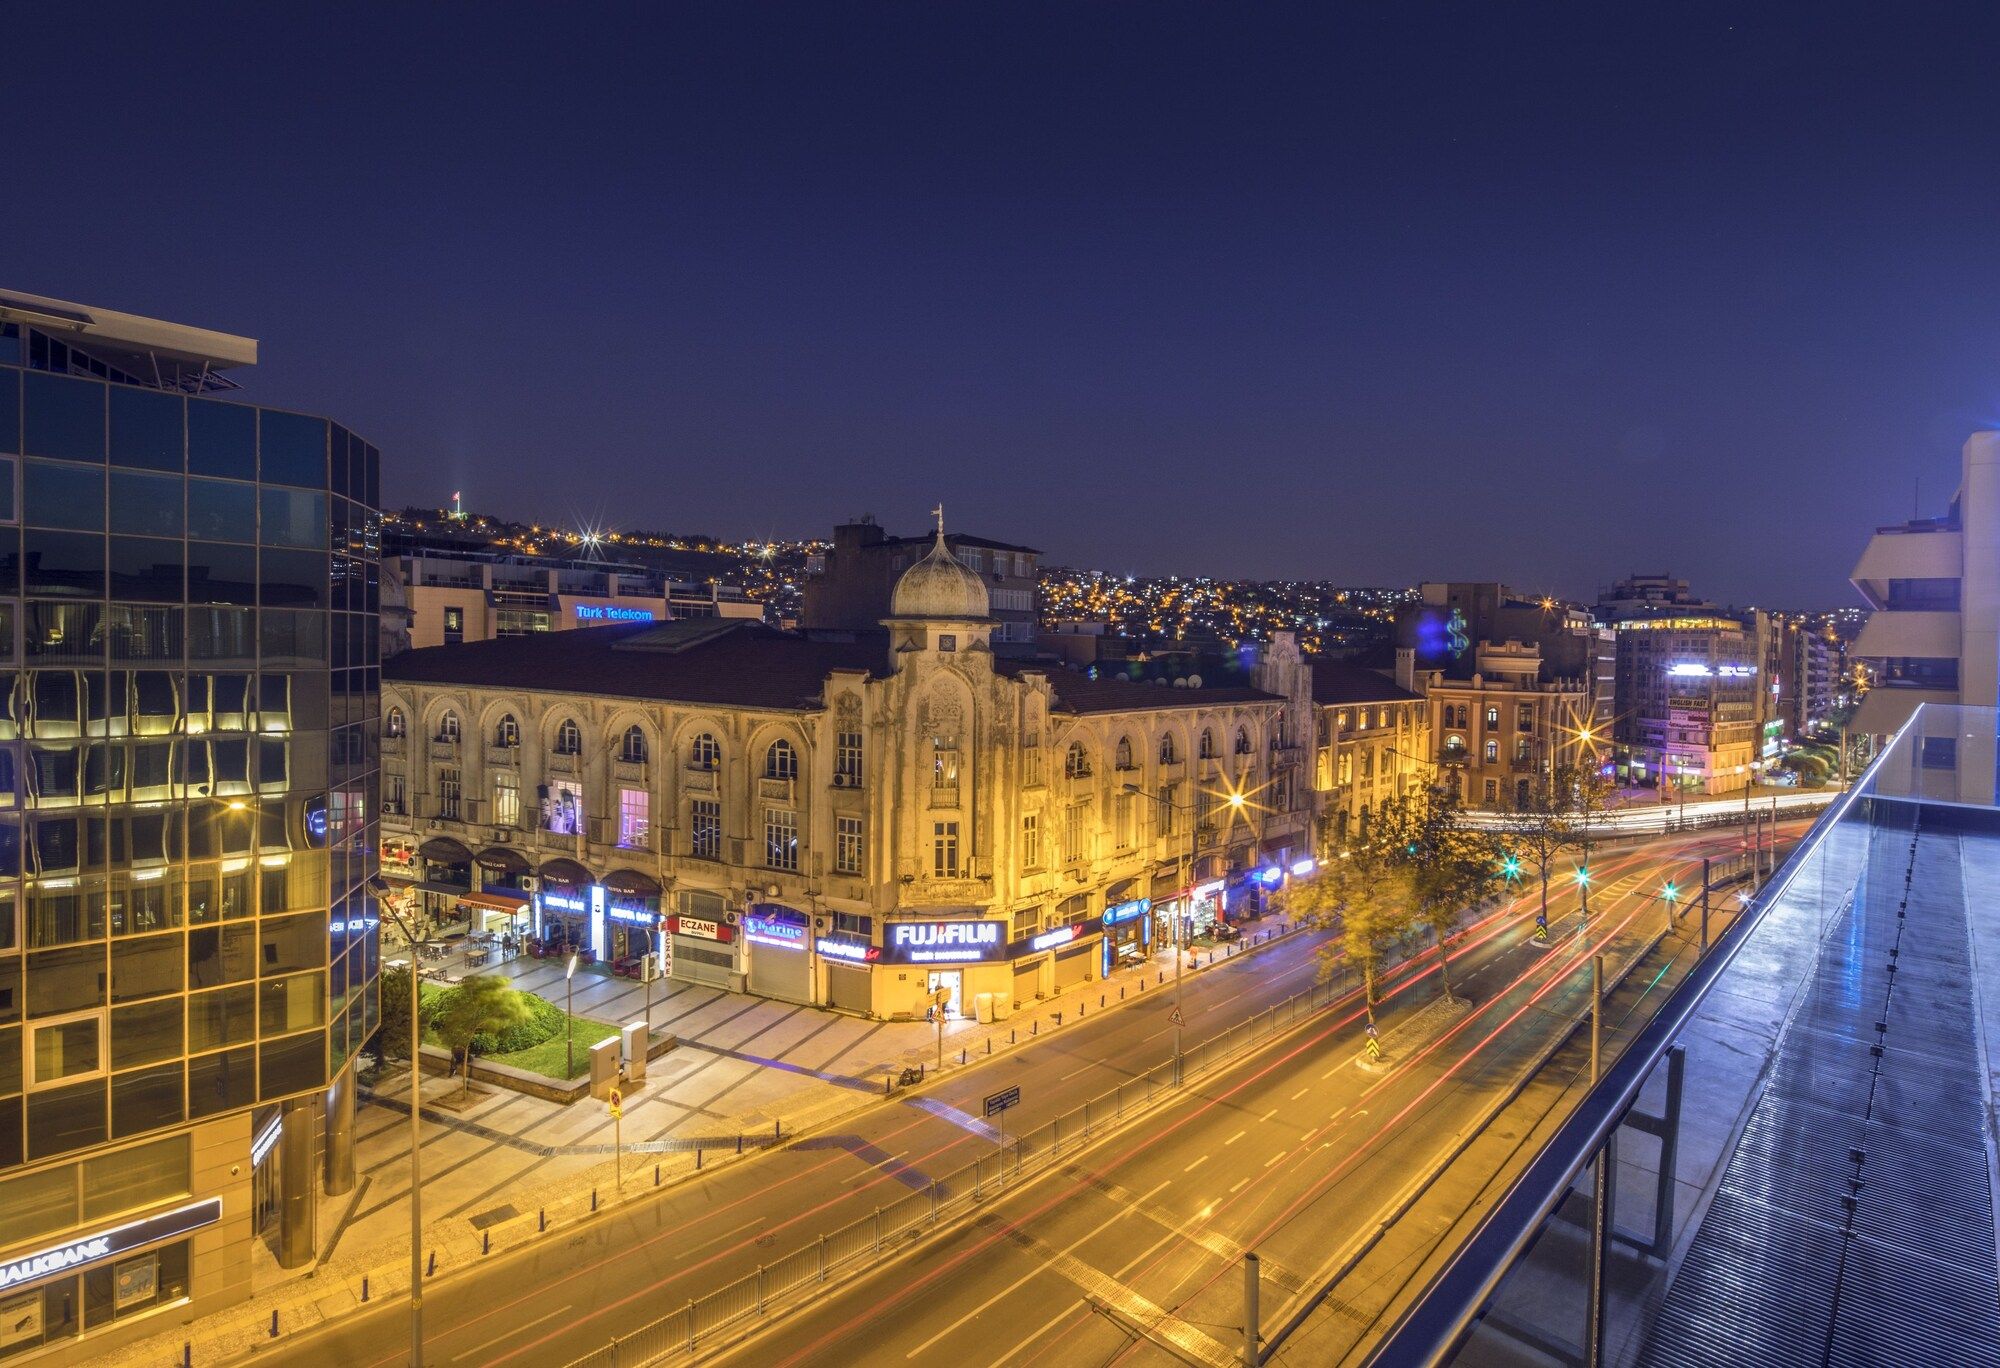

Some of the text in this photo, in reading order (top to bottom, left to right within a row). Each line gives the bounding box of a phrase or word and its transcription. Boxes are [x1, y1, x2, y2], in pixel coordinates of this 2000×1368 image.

[577, 606, 652, 620] Türk Telekom
[1693, 699, 1707, 708] FAST
[681, 919, 715, 933] ECZANE
[757, 920, 802, 937] Marine
[896, 924, 997, 945] FUJIFILM
